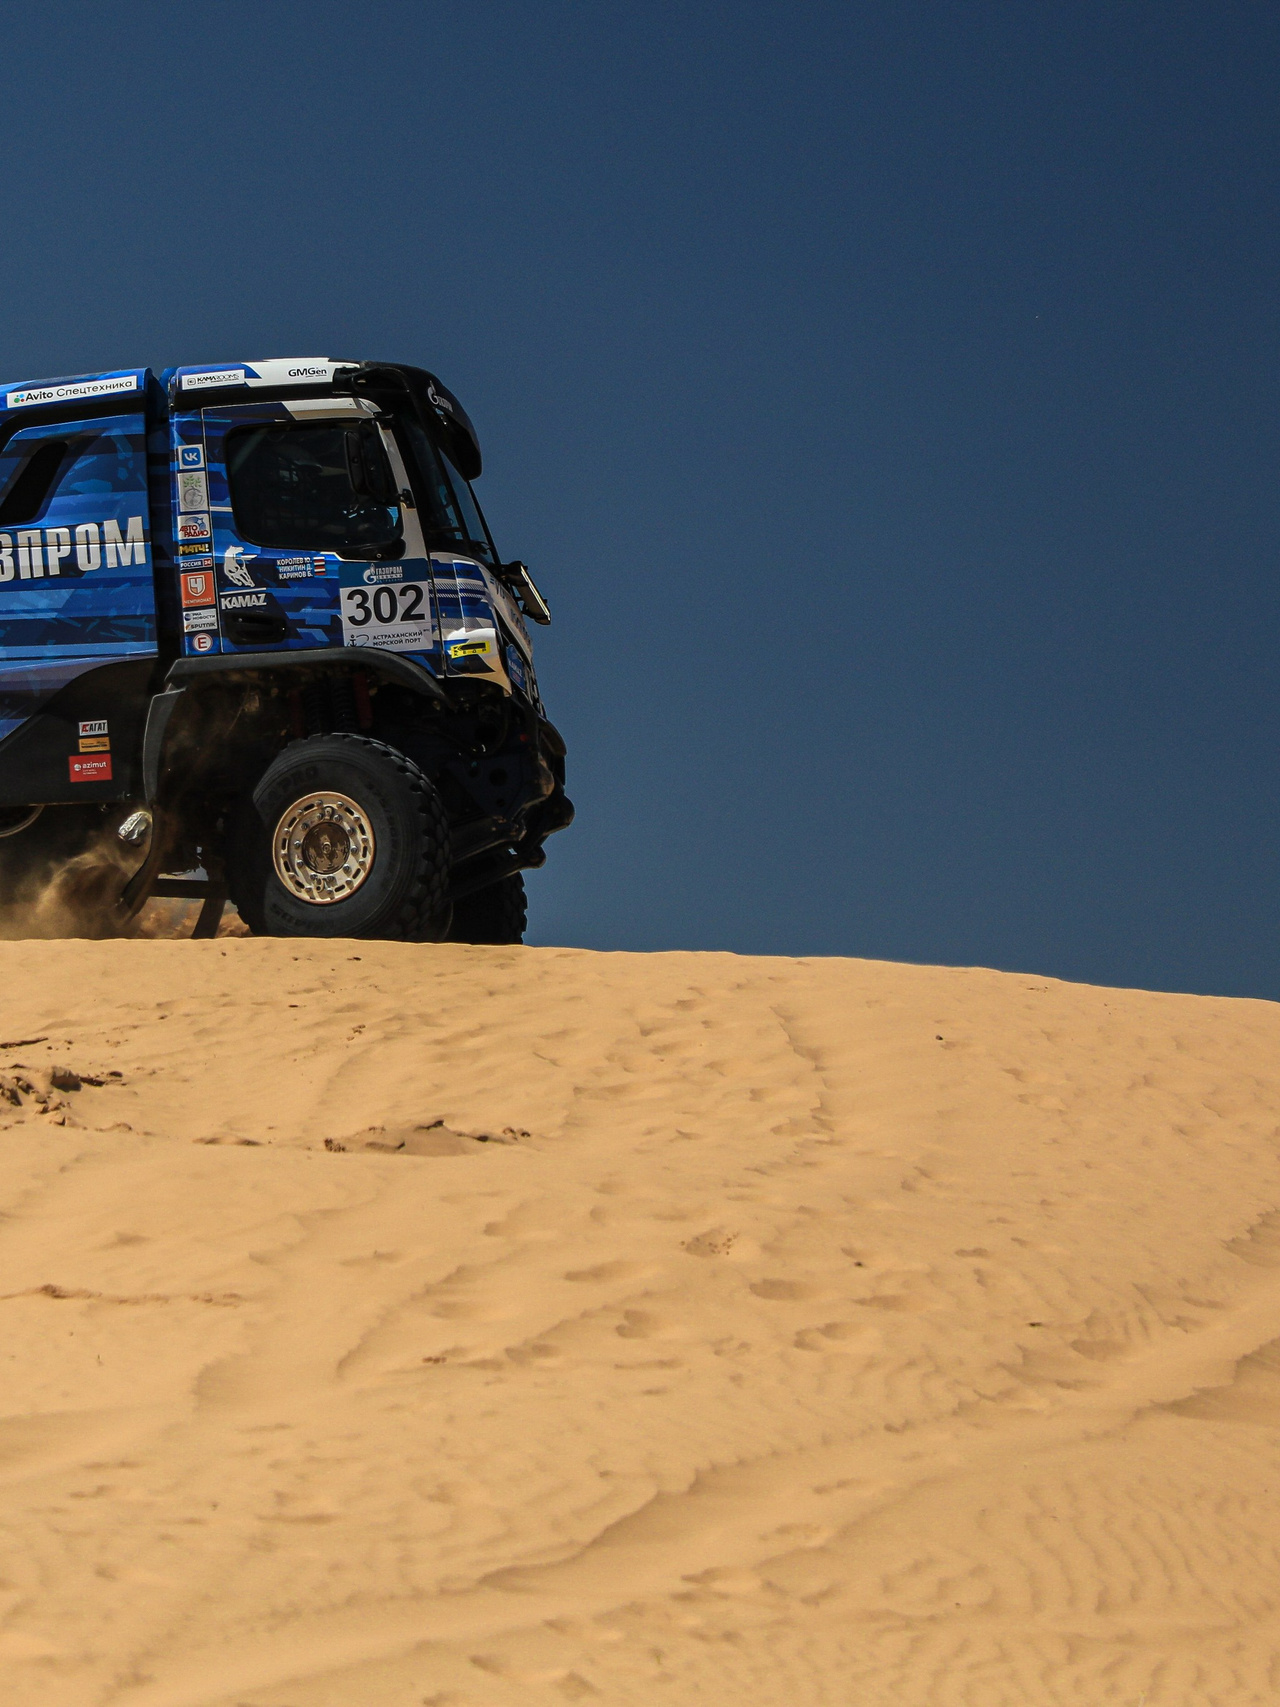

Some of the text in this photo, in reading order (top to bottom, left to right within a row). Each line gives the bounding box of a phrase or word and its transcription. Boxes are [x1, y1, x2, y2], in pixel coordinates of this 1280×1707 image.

[25, 380, 133, 402] Avito Спецтехника
[180, 560, 202, 568] РОССИЯ
[279, 564, 306, 573] НИКИТИН
[278, 571, 307, 580] КАРИМОВ
[220, 593, 268, 610] KAMAZ
[346, 584, 426, 627] 302
[190, 622, 216, 630] SPUTNIK
[373, 630, 423, 641] АСТРАХАНСКИЙ
[373, 637, 422, 647] МОРСКОЙ ПОРТ
[82, 761, 107, 769] azimut
